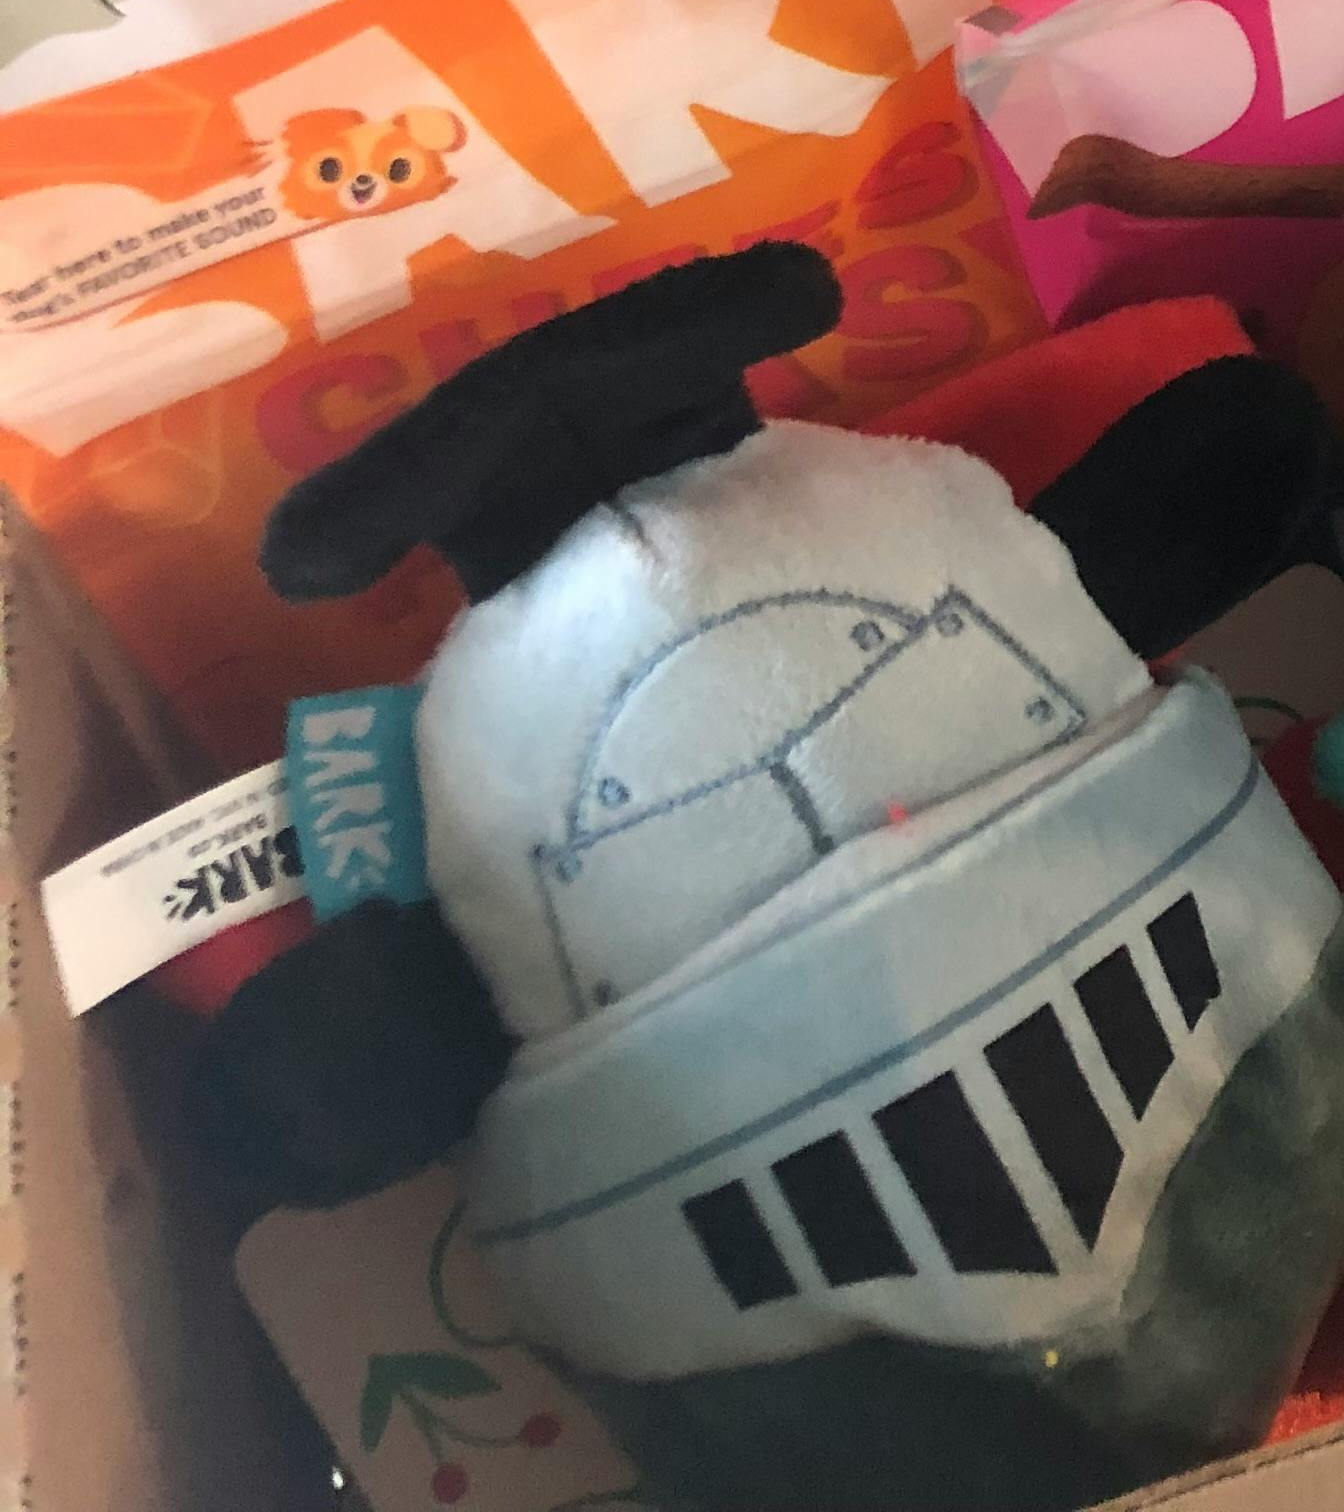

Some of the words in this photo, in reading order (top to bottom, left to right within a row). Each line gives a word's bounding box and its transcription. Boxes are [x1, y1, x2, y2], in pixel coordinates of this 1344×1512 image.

[77, 238, 191, 295] FAVORITE
[194, 207, 277, 250] SOUND
[148, 208, 210, 239] make
[214, 186, 265, 217] your
[302, 705, 393, 892] BARK
[176, 824, 305, 921] BARK
